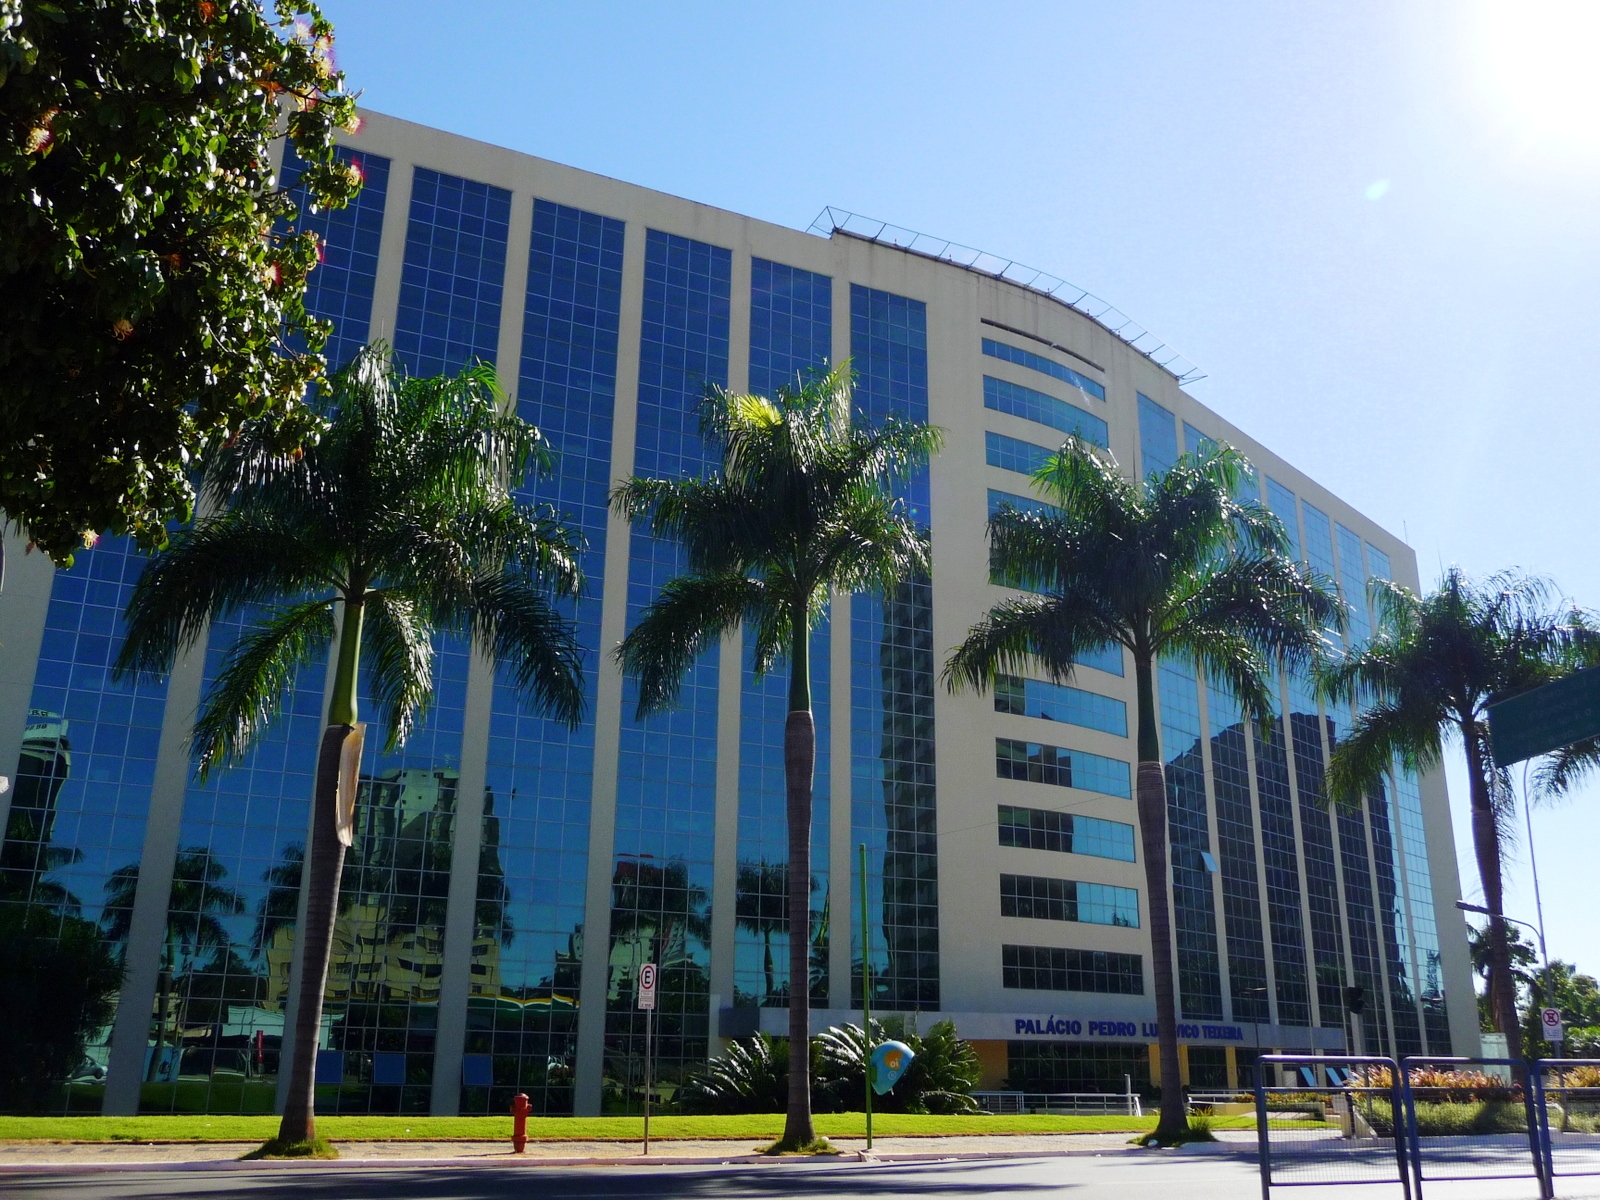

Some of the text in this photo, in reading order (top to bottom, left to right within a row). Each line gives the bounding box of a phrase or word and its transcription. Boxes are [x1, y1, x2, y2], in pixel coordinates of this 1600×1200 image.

[645, 971, 651, 984] E
[1015, 1015, 1244, 1041] PALÁCIO PEDRO LUVICO TEIXEIRA
